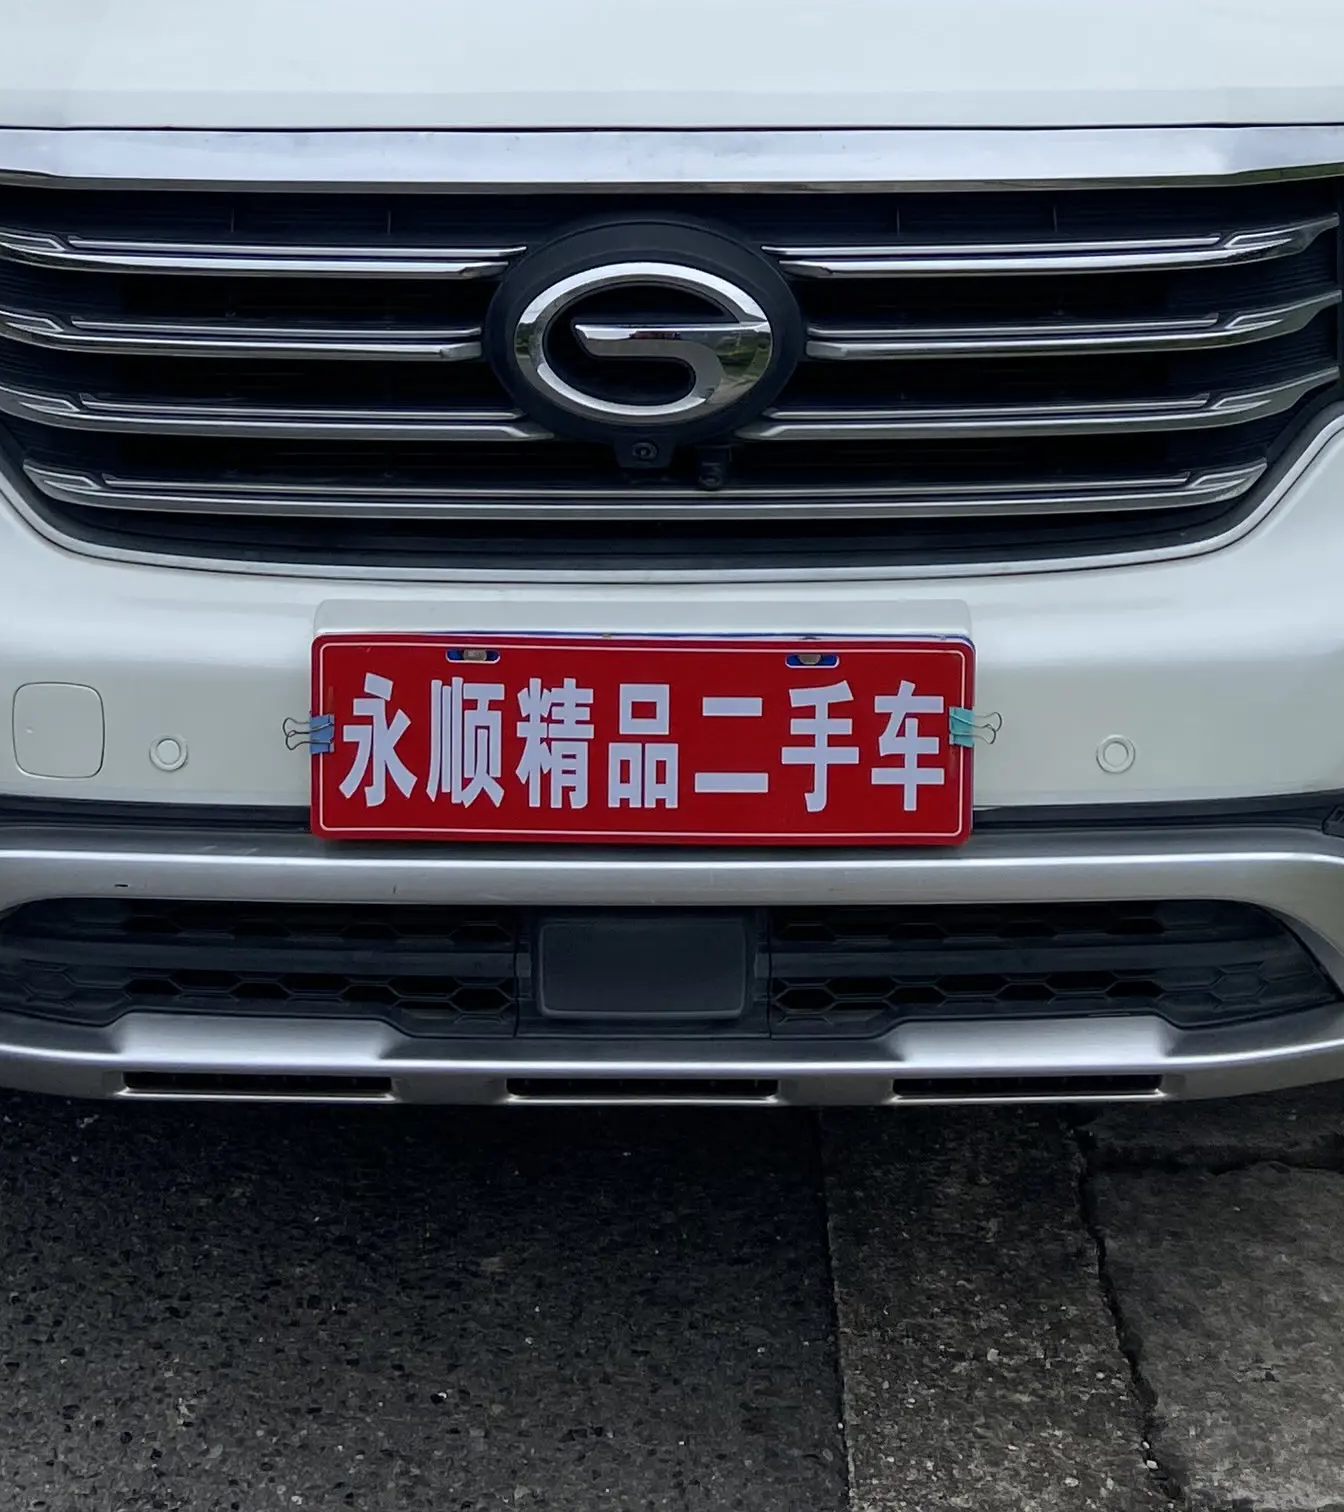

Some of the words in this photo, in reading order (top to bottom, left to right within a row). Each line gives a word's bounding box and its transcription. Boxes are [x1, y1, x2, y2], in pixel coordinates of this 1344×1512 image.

[338, 672, 947, 813] 永顺精品二手车
